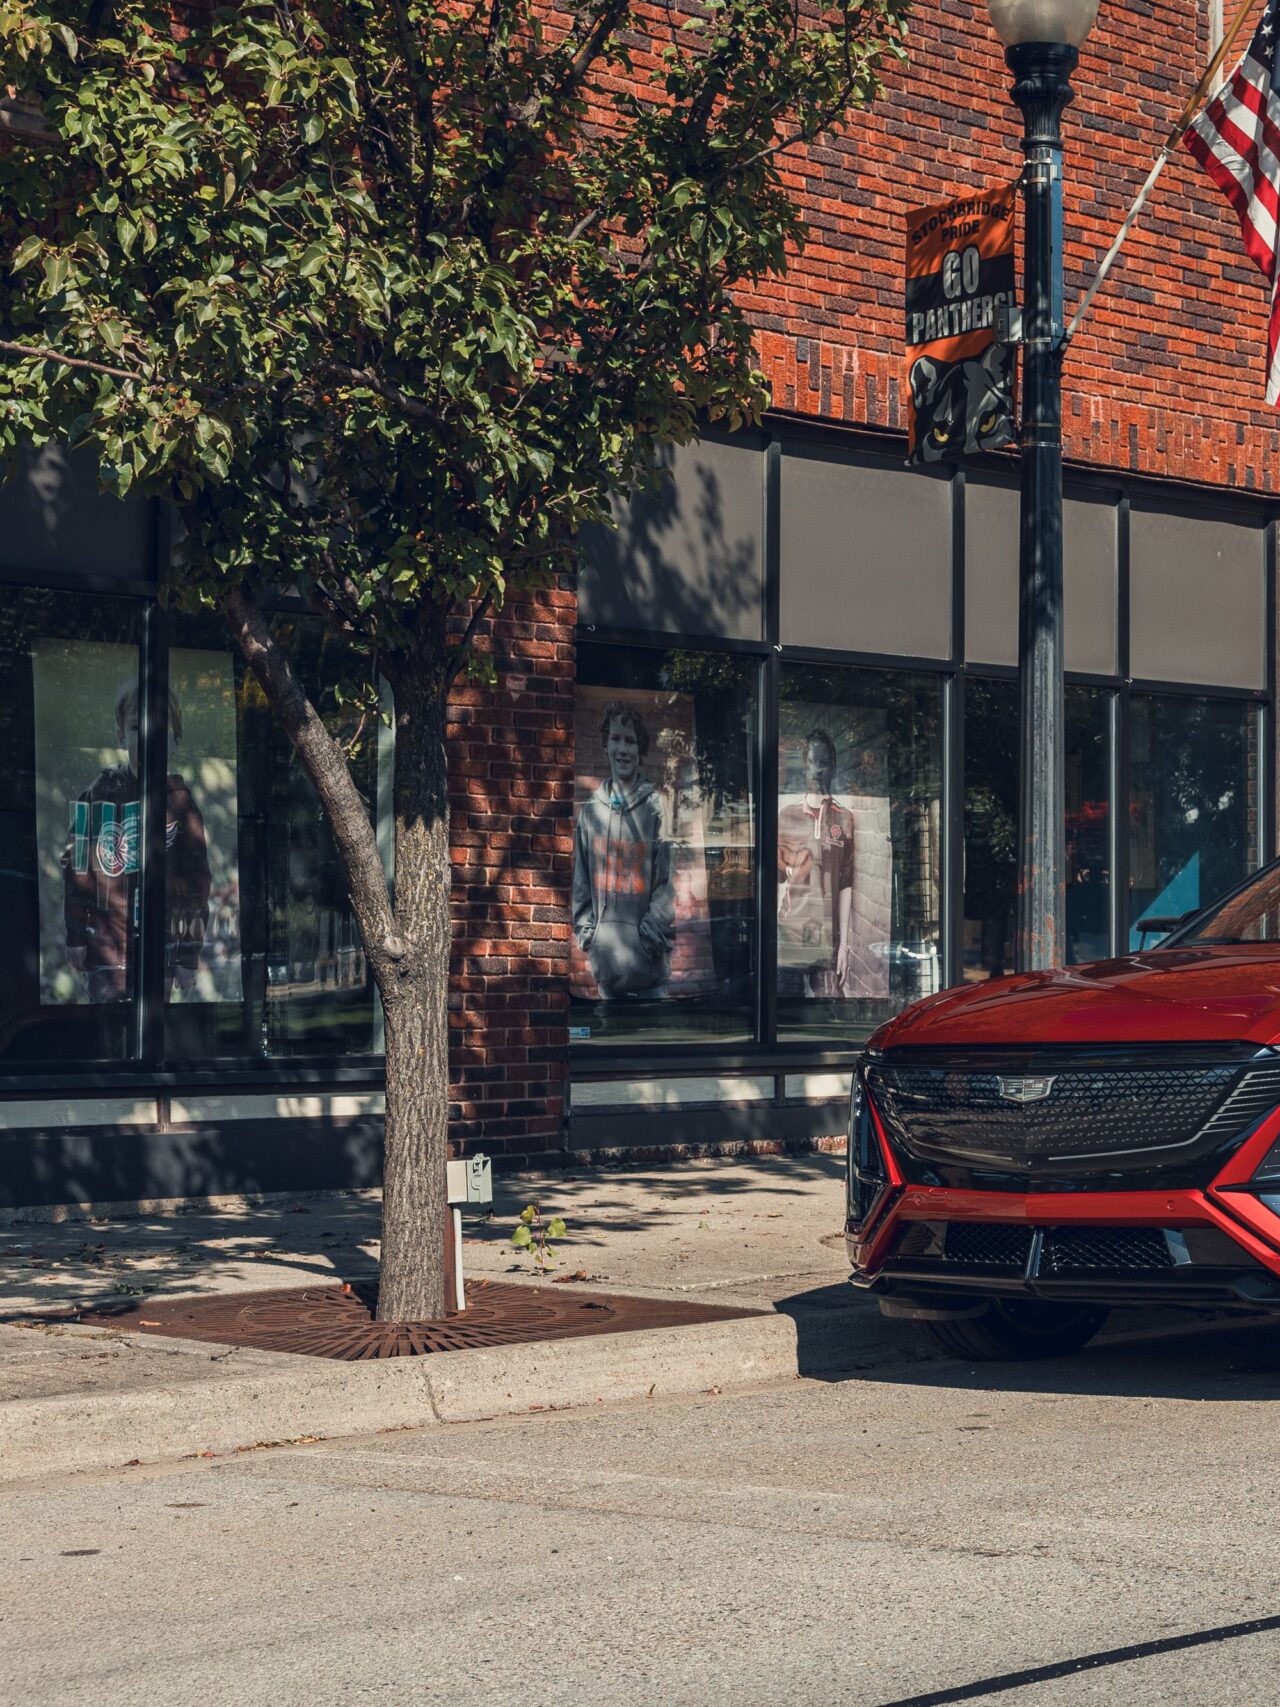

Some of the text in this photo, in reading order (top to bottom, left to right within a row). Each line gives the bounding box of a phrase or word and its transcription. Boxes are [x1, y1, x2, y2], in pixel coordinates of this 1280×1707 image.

[912, 200, 1010, 244] STOCKBRIDGE
[942, 220, 980, 242] PRIDE
[943, 247, 980, 299] GO
